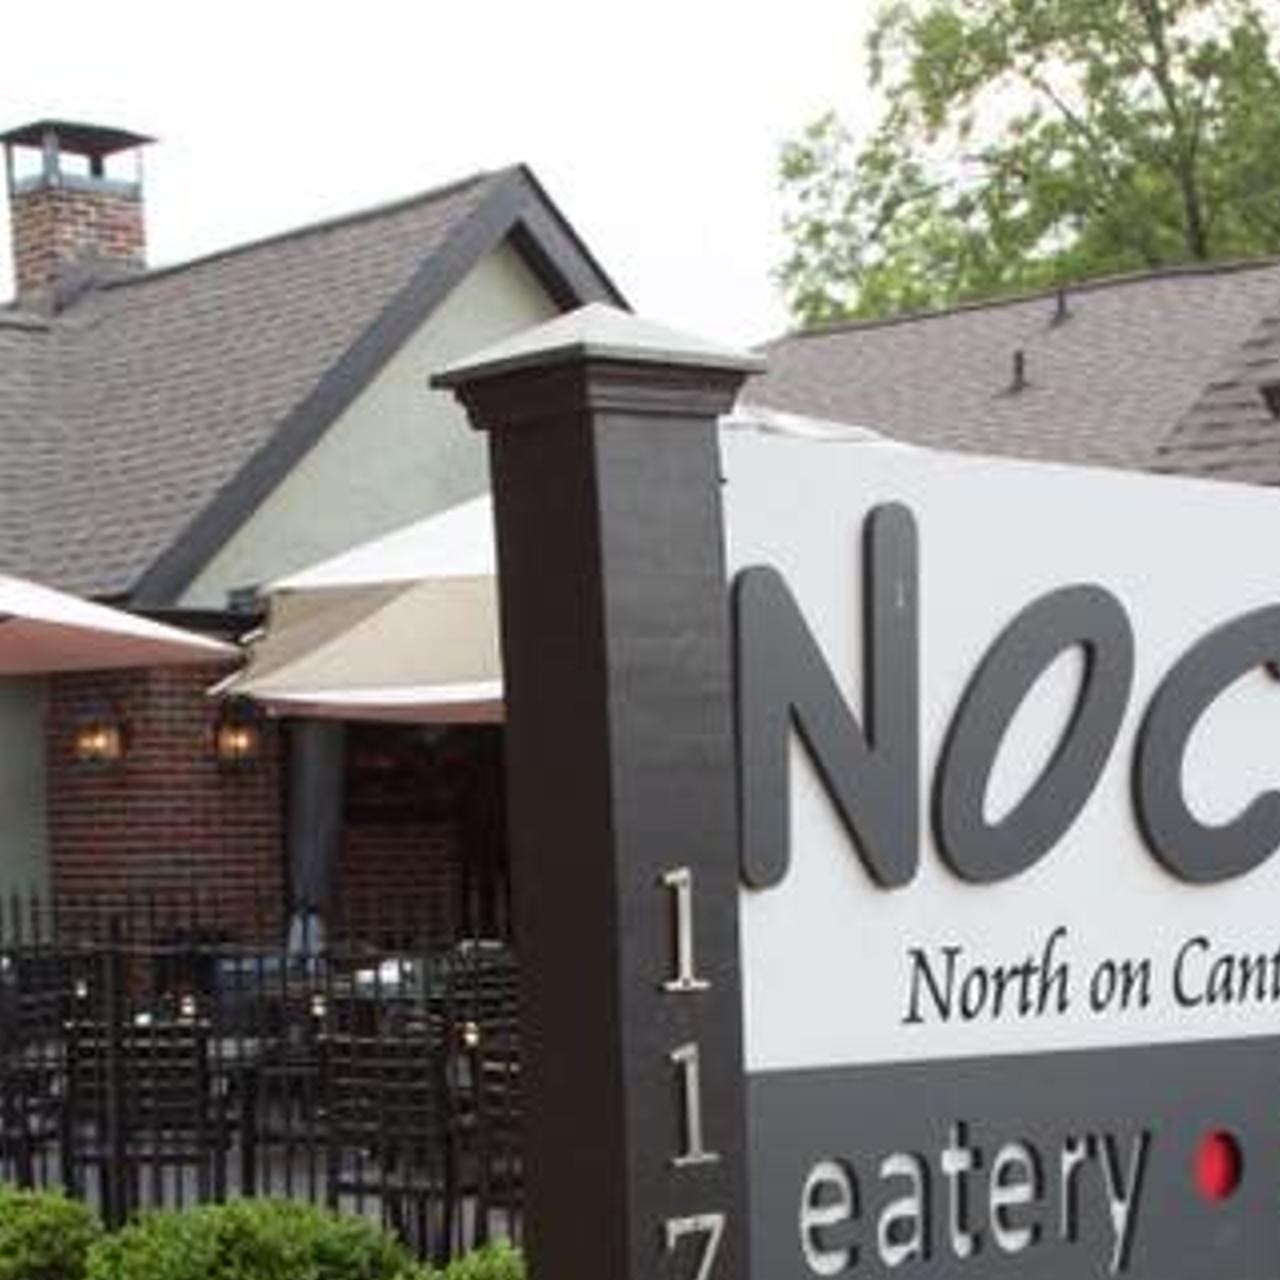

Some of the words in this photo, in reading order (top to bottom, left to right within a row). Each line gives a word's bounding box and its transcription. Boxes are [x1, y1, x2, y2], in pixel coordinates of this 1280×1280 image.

[903, 927, 1068, 1024] North
[1090, 960, 1152, 1010] on
[799, 1120, 1150, 1277] eatery
